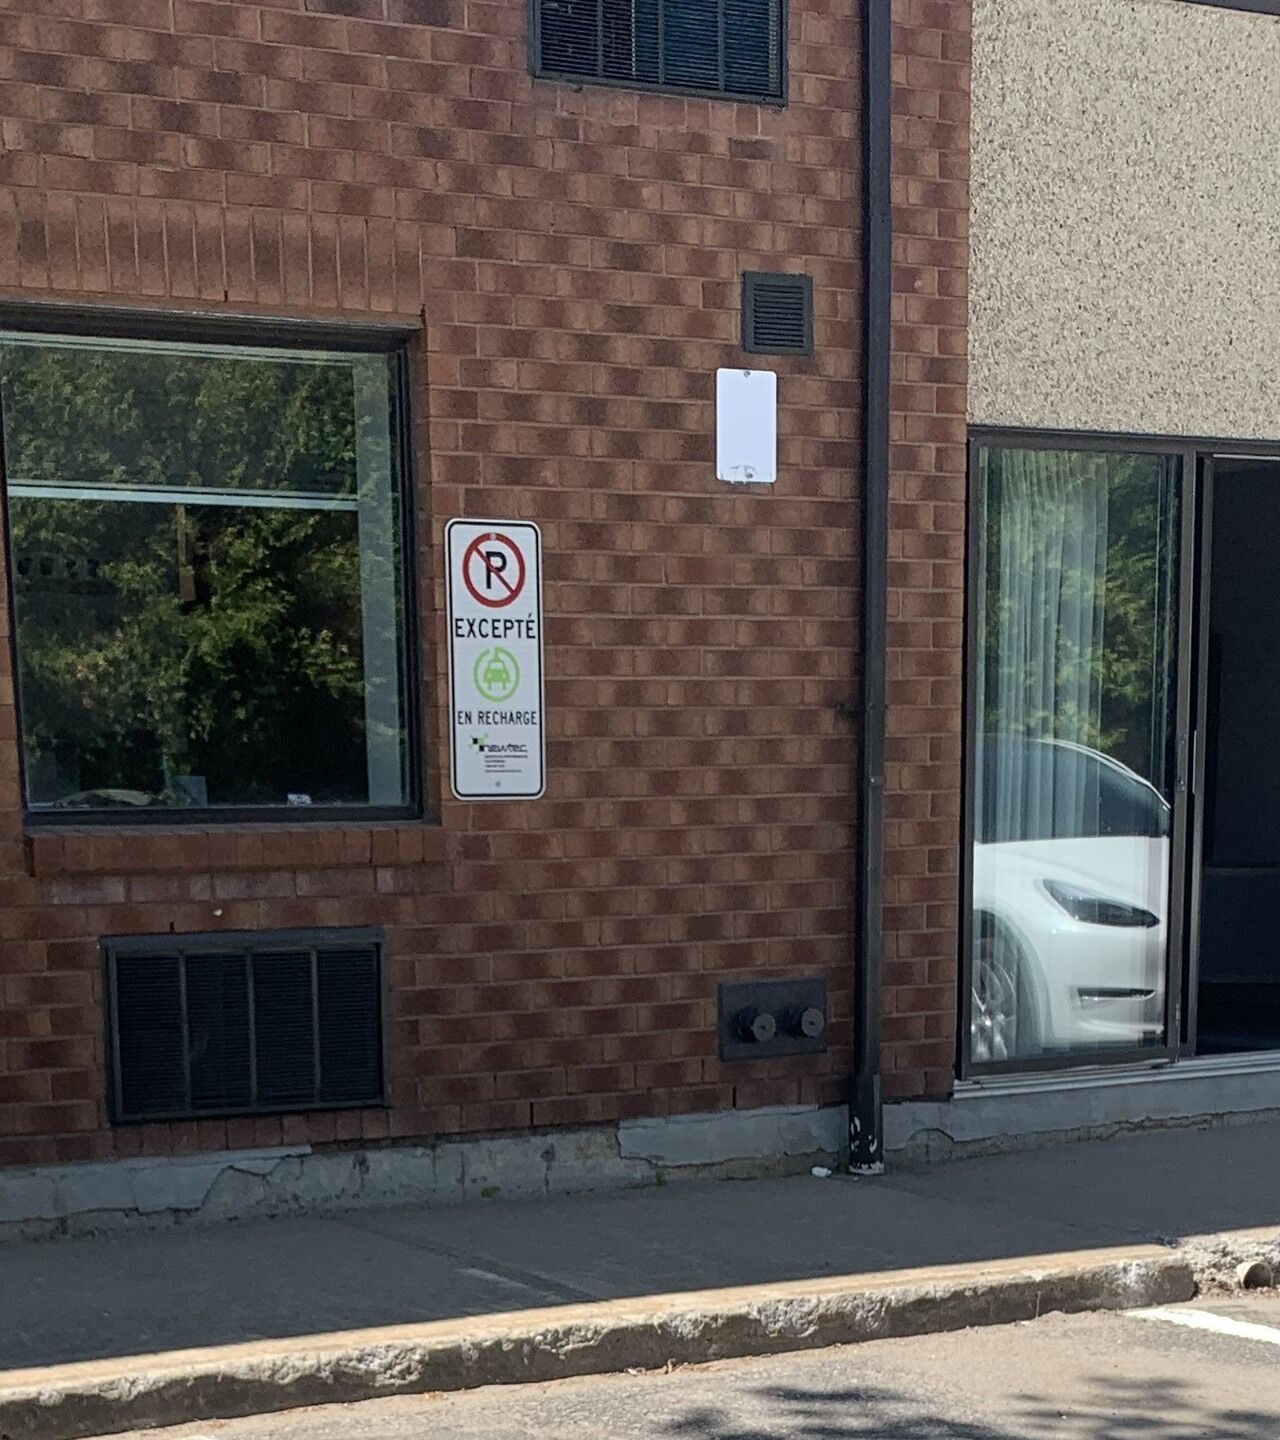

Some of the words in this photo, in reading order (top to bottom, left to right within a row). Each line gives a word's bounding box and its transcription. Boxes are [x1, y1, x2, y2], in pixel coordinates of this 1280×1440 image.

[485, 551, 508, 590] P
[455, 613, 536, 639] EXCEPTÉ
[457, 711, 472, 725] EN
[477, 710, 538, 726] RECHARGE
